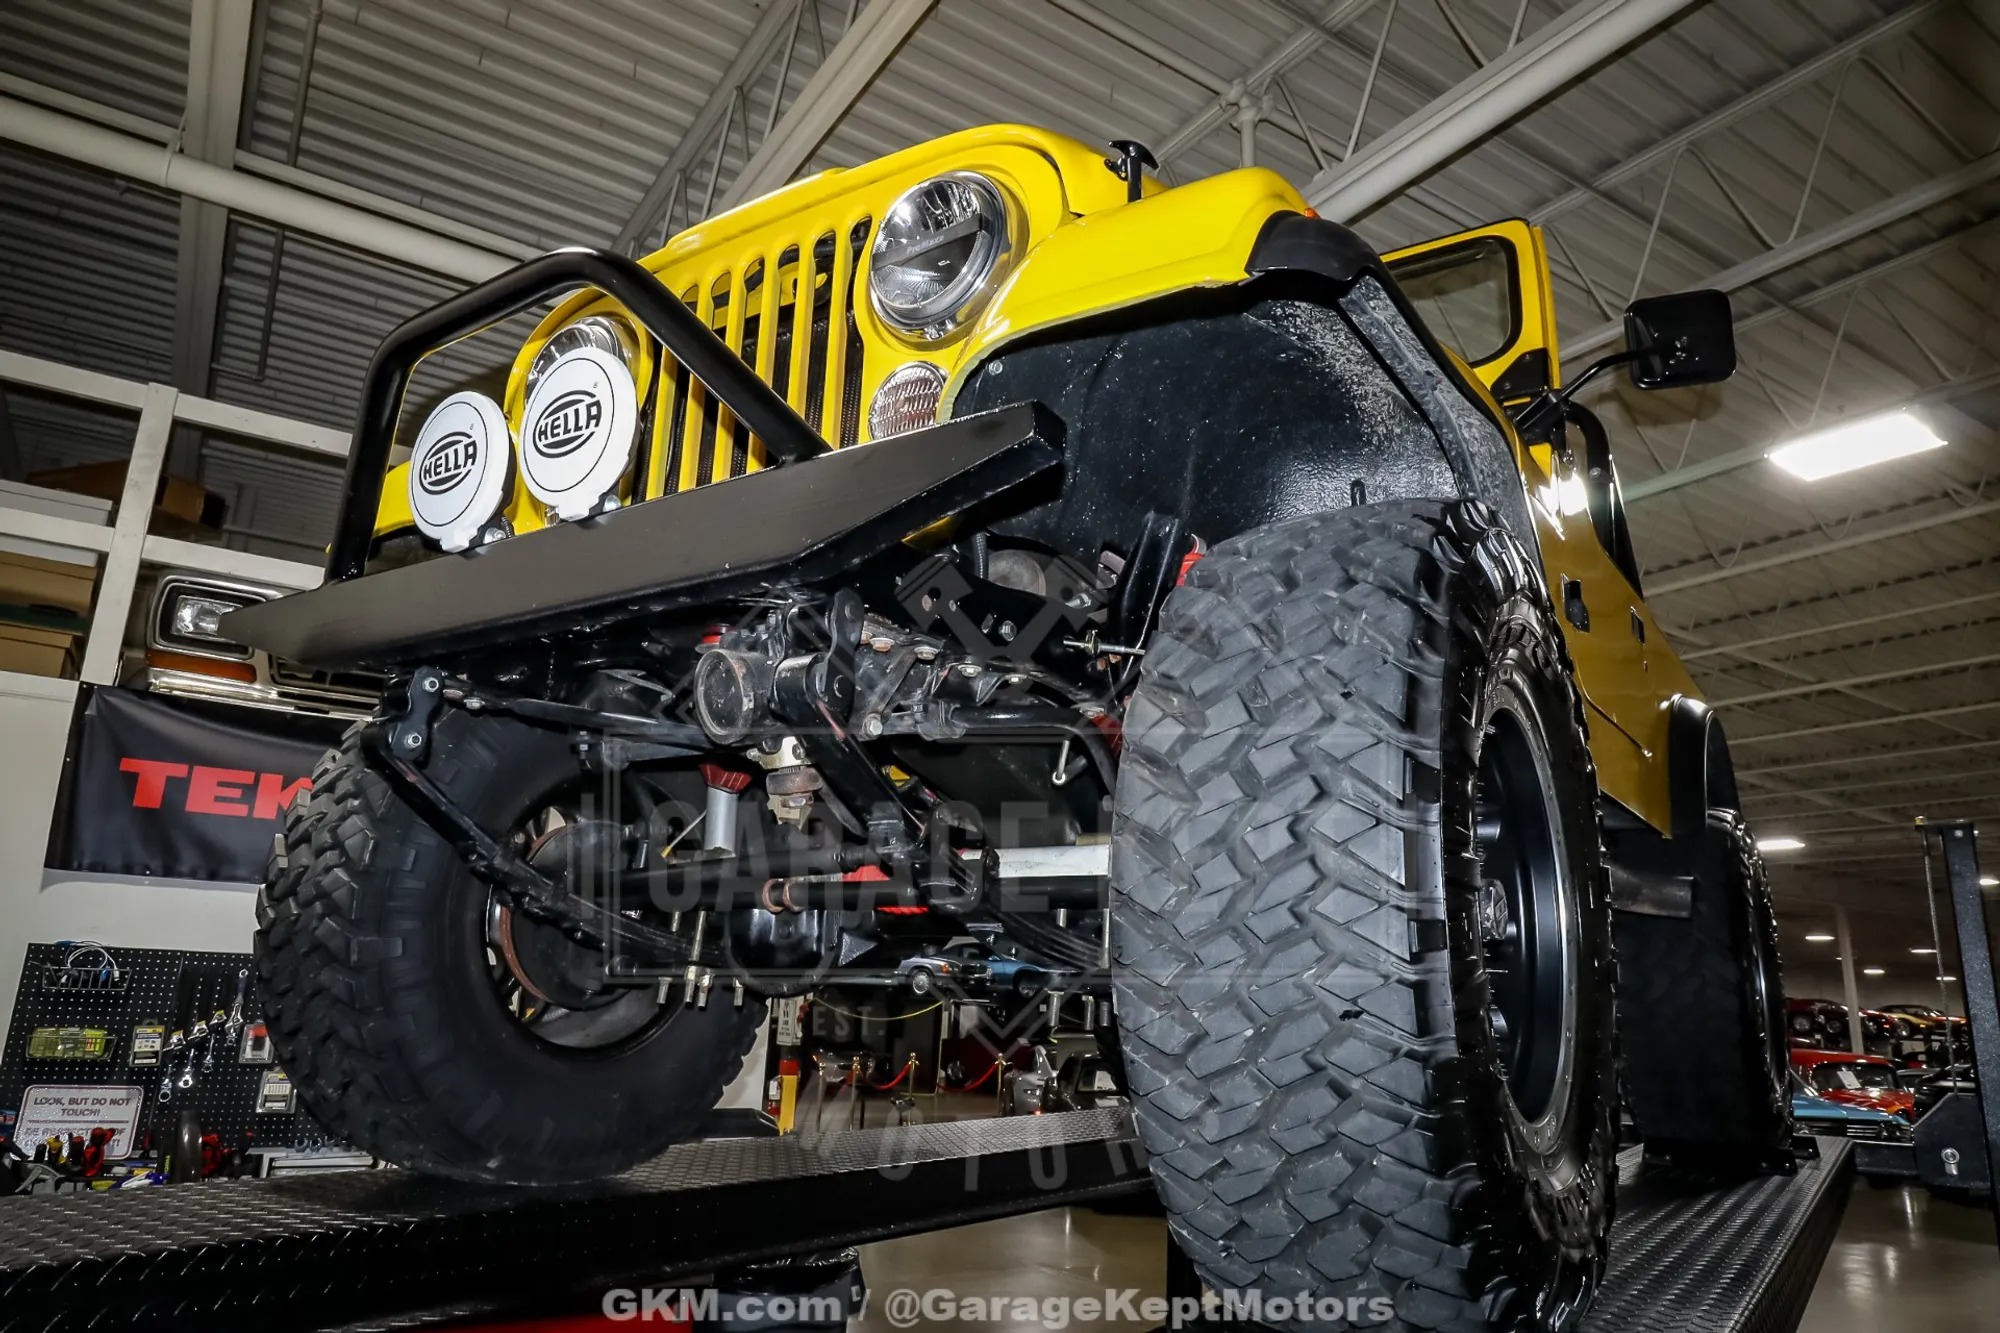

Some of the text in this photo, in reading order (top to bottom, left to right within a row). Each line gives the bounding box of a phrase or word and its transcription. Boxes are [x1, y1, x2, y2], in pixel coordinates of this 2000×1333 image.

[538, 399, 602, 443] HELLA
[423, 440, 478, 481] HELLA
[33, 1097, 132, 1108] LOOK, BUT DO NOT
[60, 1108, 101, 1117] TOUCH!
